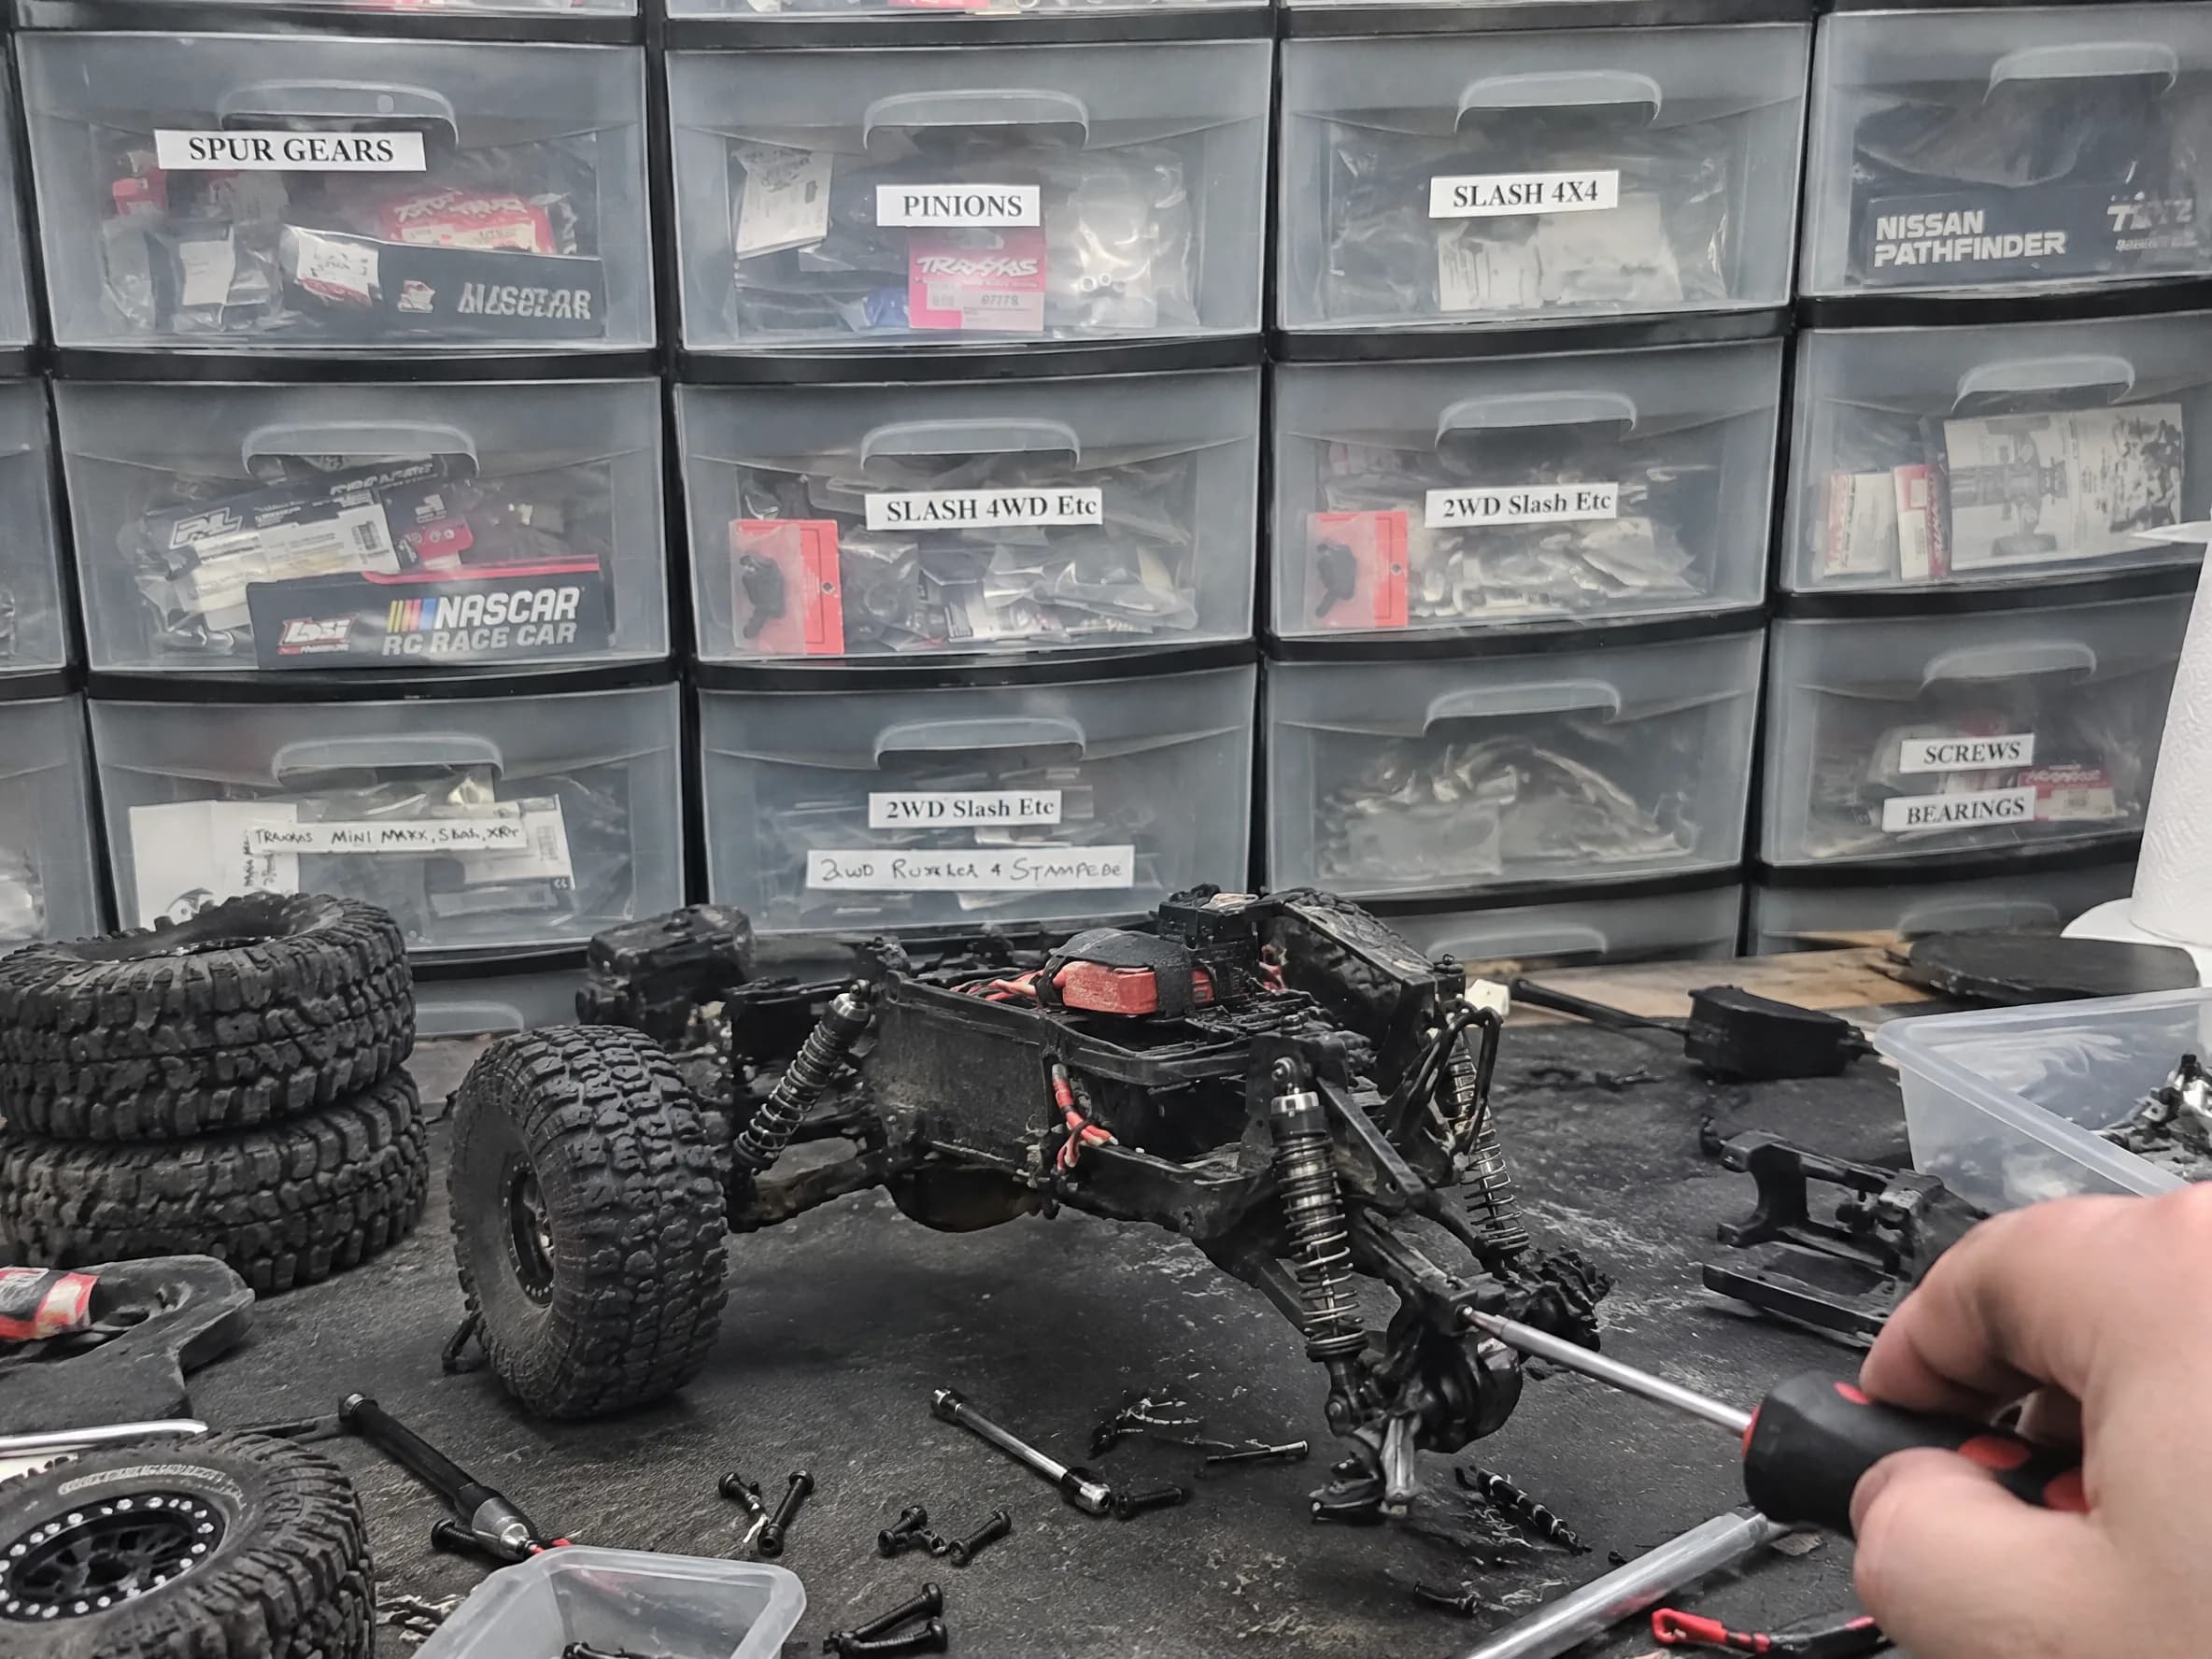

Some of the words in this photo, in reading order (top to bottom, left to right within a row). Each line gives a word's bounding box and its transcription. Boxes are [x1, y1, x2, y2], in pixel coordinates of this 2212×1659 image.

[189, 136, 275, 162] SPUR
[283, 138, 394, 163] GEARS
[903, 194, 1023, 218] PINIONS
[1453, 182, 1544, 207] SLASH
[1552, 179, 1598, 203] 4X4
[1877, 210, 1983, 241] NISSAN
[1875, 232, 2066, 266] PATHFINDER
[916, 256, 1039, 277] TRAXXAS
[886, 499, 977, 522] SLASH
[985, 496, 1048, 518] 4WD
[1057, 495, 1097, 516] Etc
[1443, 496, 1501, 518] 2WD
[1509, 492, 1567, 515] Slash
[1576, 491, 1611, 511] Etc
[433, 588, 579, 629] NASCAR
[383, 633, 423, 656] RC
[431, 626, 509, 654] RACE
[517, 622, 576, 645] CAR
[1924, 742, 2021, 764] SCREWS
[886, 801, 945, 819] 2WD
[953, 799, 1011, 817] Slash
[1019, 798, 1055, 815] Etc
[1906, 798, 2024, 824] BEARINGS
